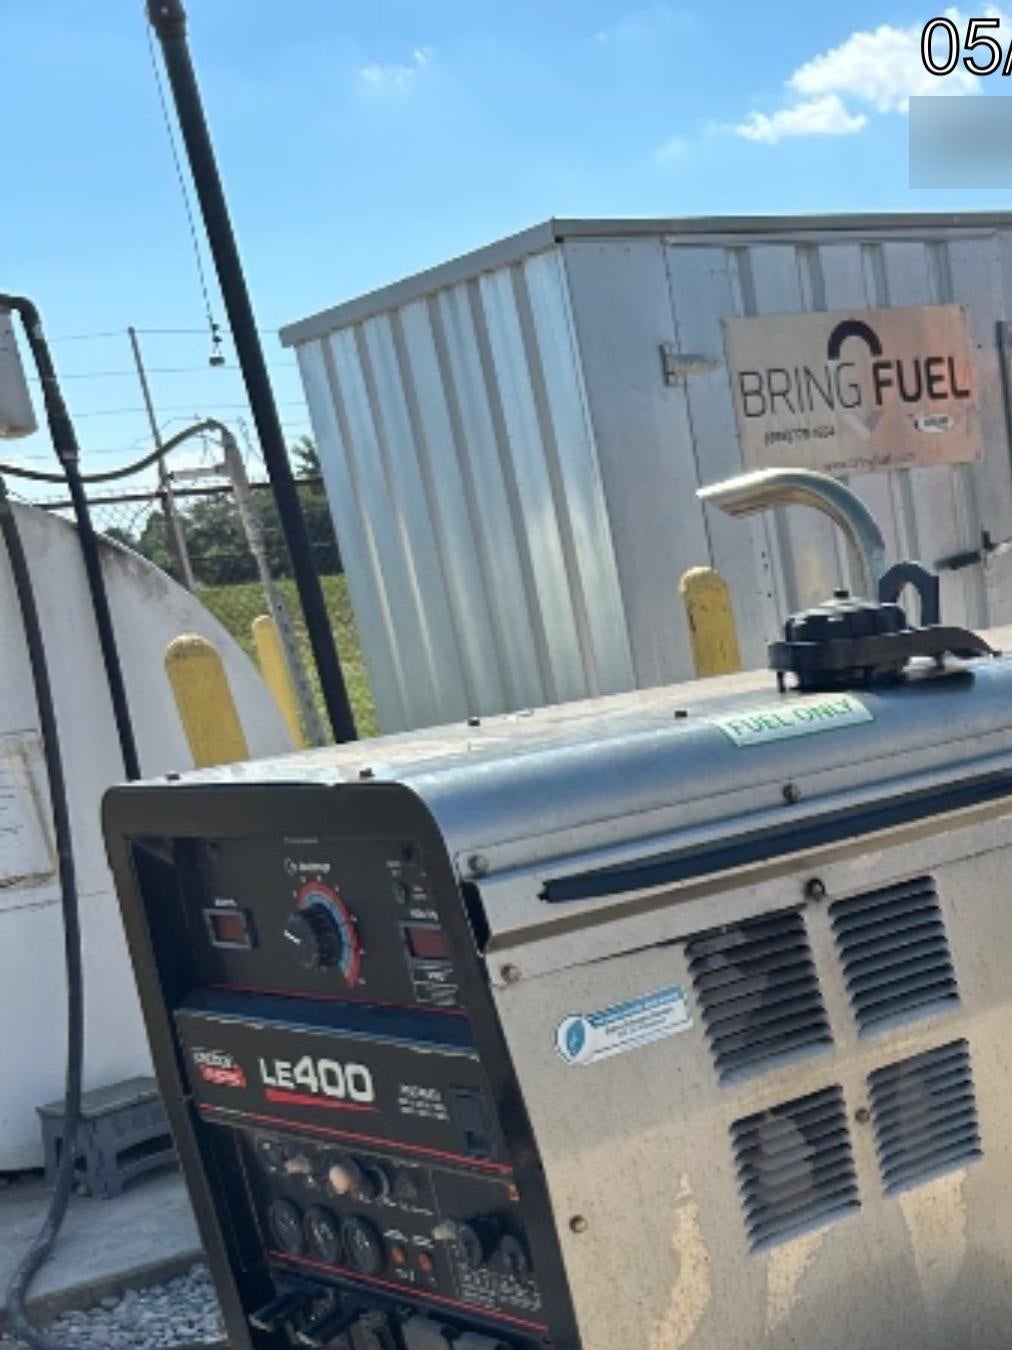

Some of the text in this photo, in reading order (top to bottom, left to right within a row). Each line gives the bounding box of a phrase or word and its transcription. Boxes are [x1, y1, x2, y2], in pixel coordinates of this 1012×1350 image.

[739, 355, 971, 418] BRING FUEL
[726, 714, 796, 737] FUEL
[258, 1055, 375, 1102] LE400
